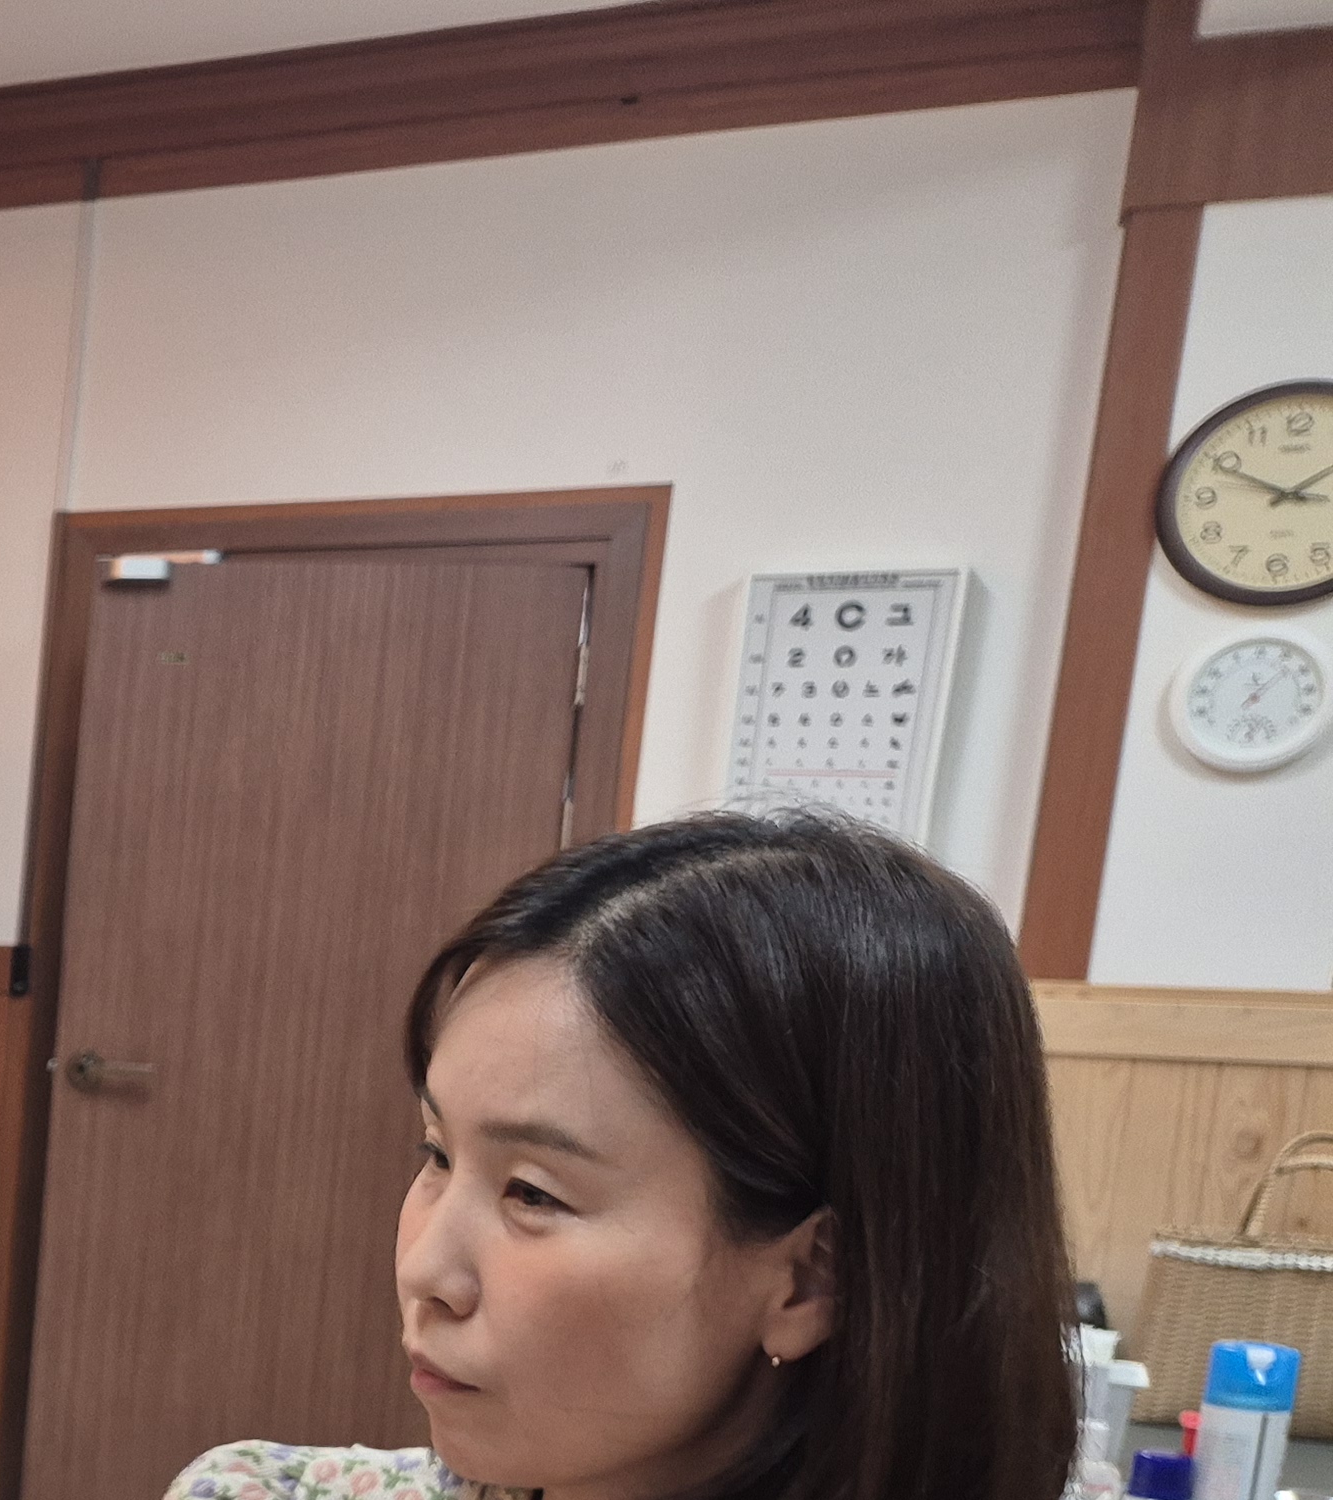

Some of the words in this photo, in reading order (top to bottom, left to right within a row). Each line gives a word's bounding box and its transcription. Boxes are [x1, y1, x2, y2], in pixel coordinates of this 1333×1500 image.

[1248, 426, 1267, 445] 11
[1196, 486, 1217, 507] 9
[1200, 521, 1222, 543] 8
[789, 602, 813, 630] 4
